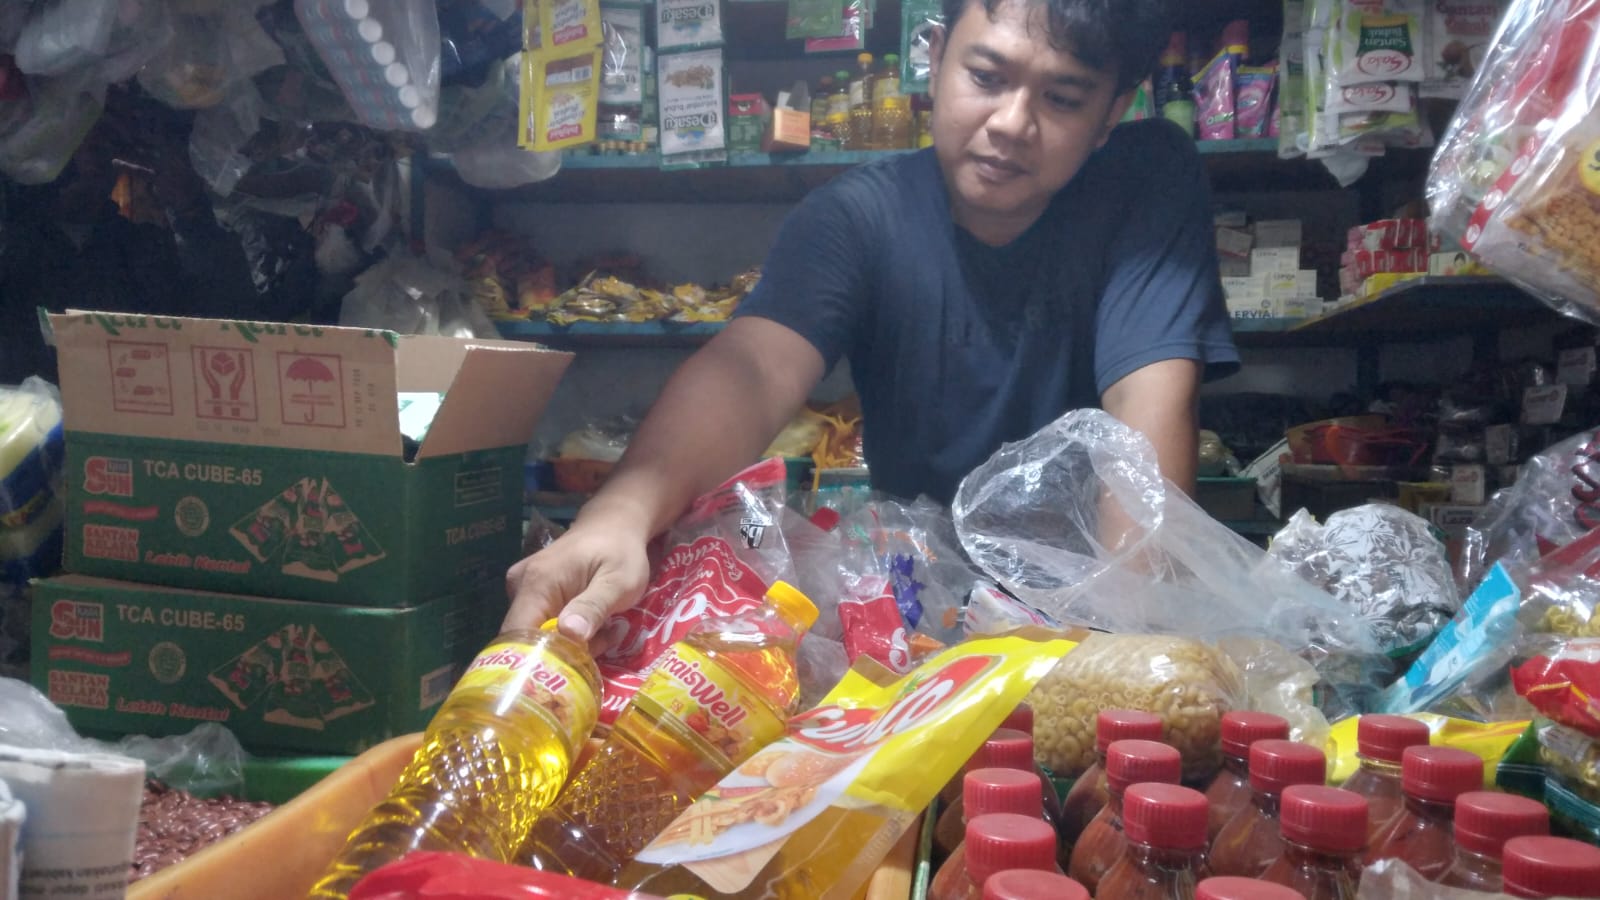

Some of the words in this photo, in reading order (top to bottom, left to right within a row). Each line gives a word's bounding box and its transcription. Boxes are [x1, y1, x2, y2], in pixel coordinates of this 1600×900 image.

[664, 112, 718, 131] Desaku
[143, 459, 180, 479] TCA
[184, 463, 263, 486] CUBE-65
[50, 600, 103, 641] SUN
[116, 604, 155, 624] TCA
[160, 608, 245, 632] CUBE-65
[50, 672, 107, 687] SANTAN
